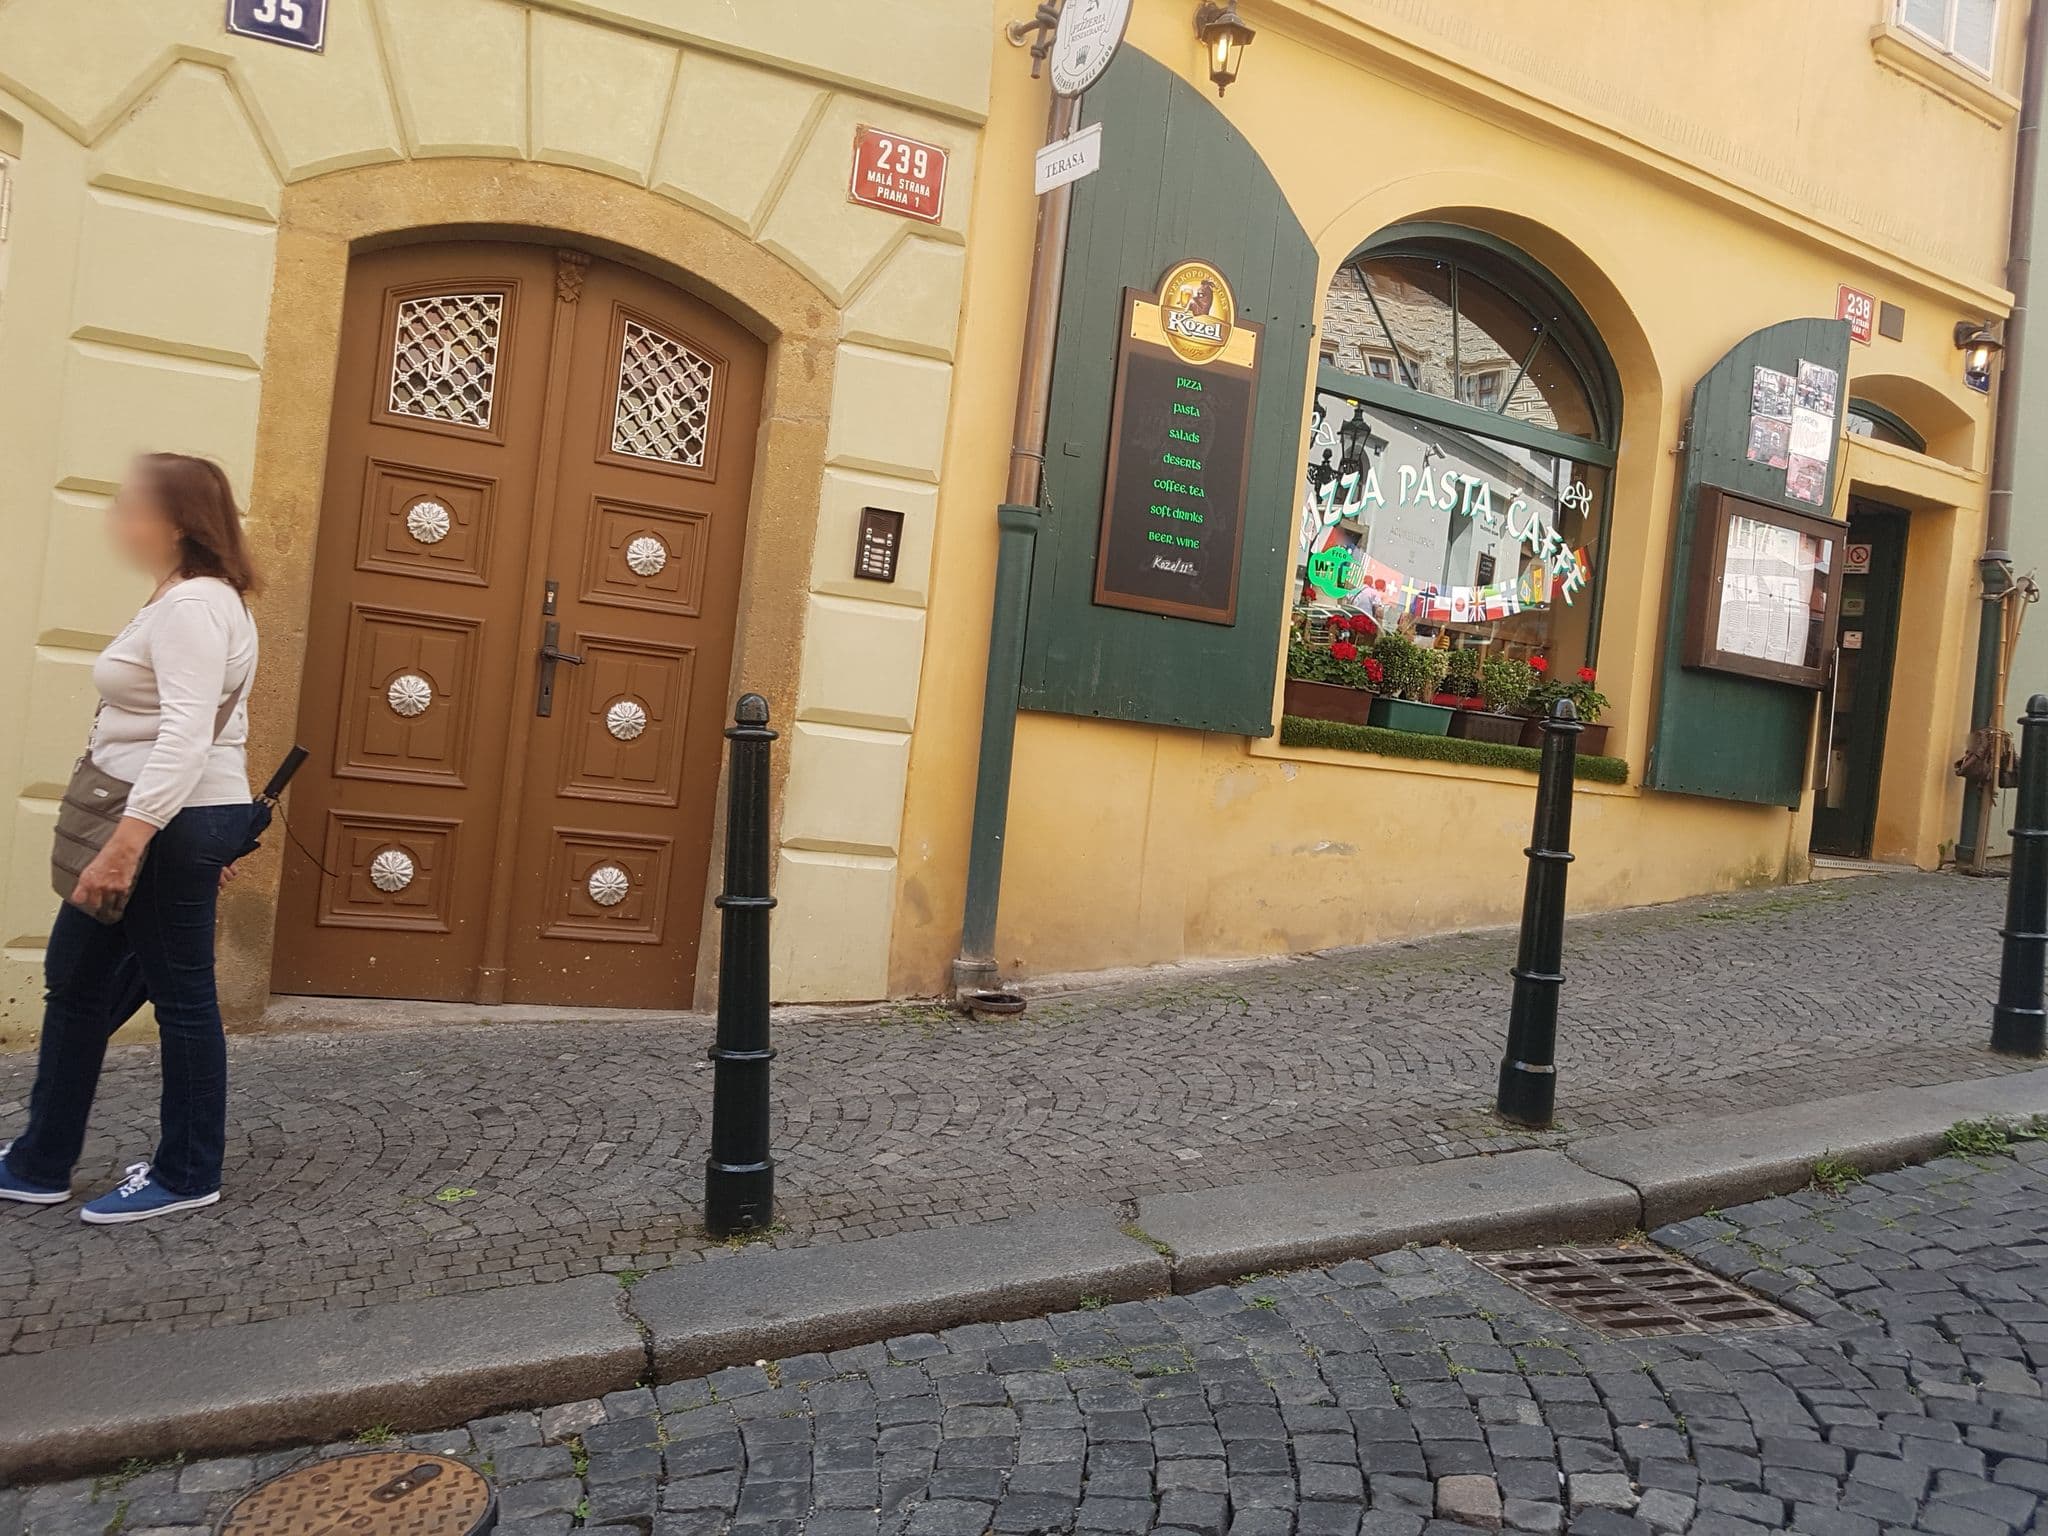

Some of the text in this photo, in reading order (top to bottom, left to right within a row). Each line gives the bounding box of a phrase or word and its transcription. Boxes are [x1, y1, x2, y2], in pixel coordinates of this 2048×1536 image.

[253, 0, 303, 29] 35
[877, 139, 928, 179] 239
[1045, 151, 1085, 178] TERASA
[867, 170, 930, 197] MALÁ STRANA
[877, 186, 921, 208] PRAHA 1
[1847, 293, 1870, 321] 238
[1167, 310, 1222, 341] Kozel
[1173, 402, 1201, 417] pasta
[1168, 428, 1201, 444] salads
[1397, 464, 1495, 526] PASTA
[1150, 504, 1172, 518] soft
